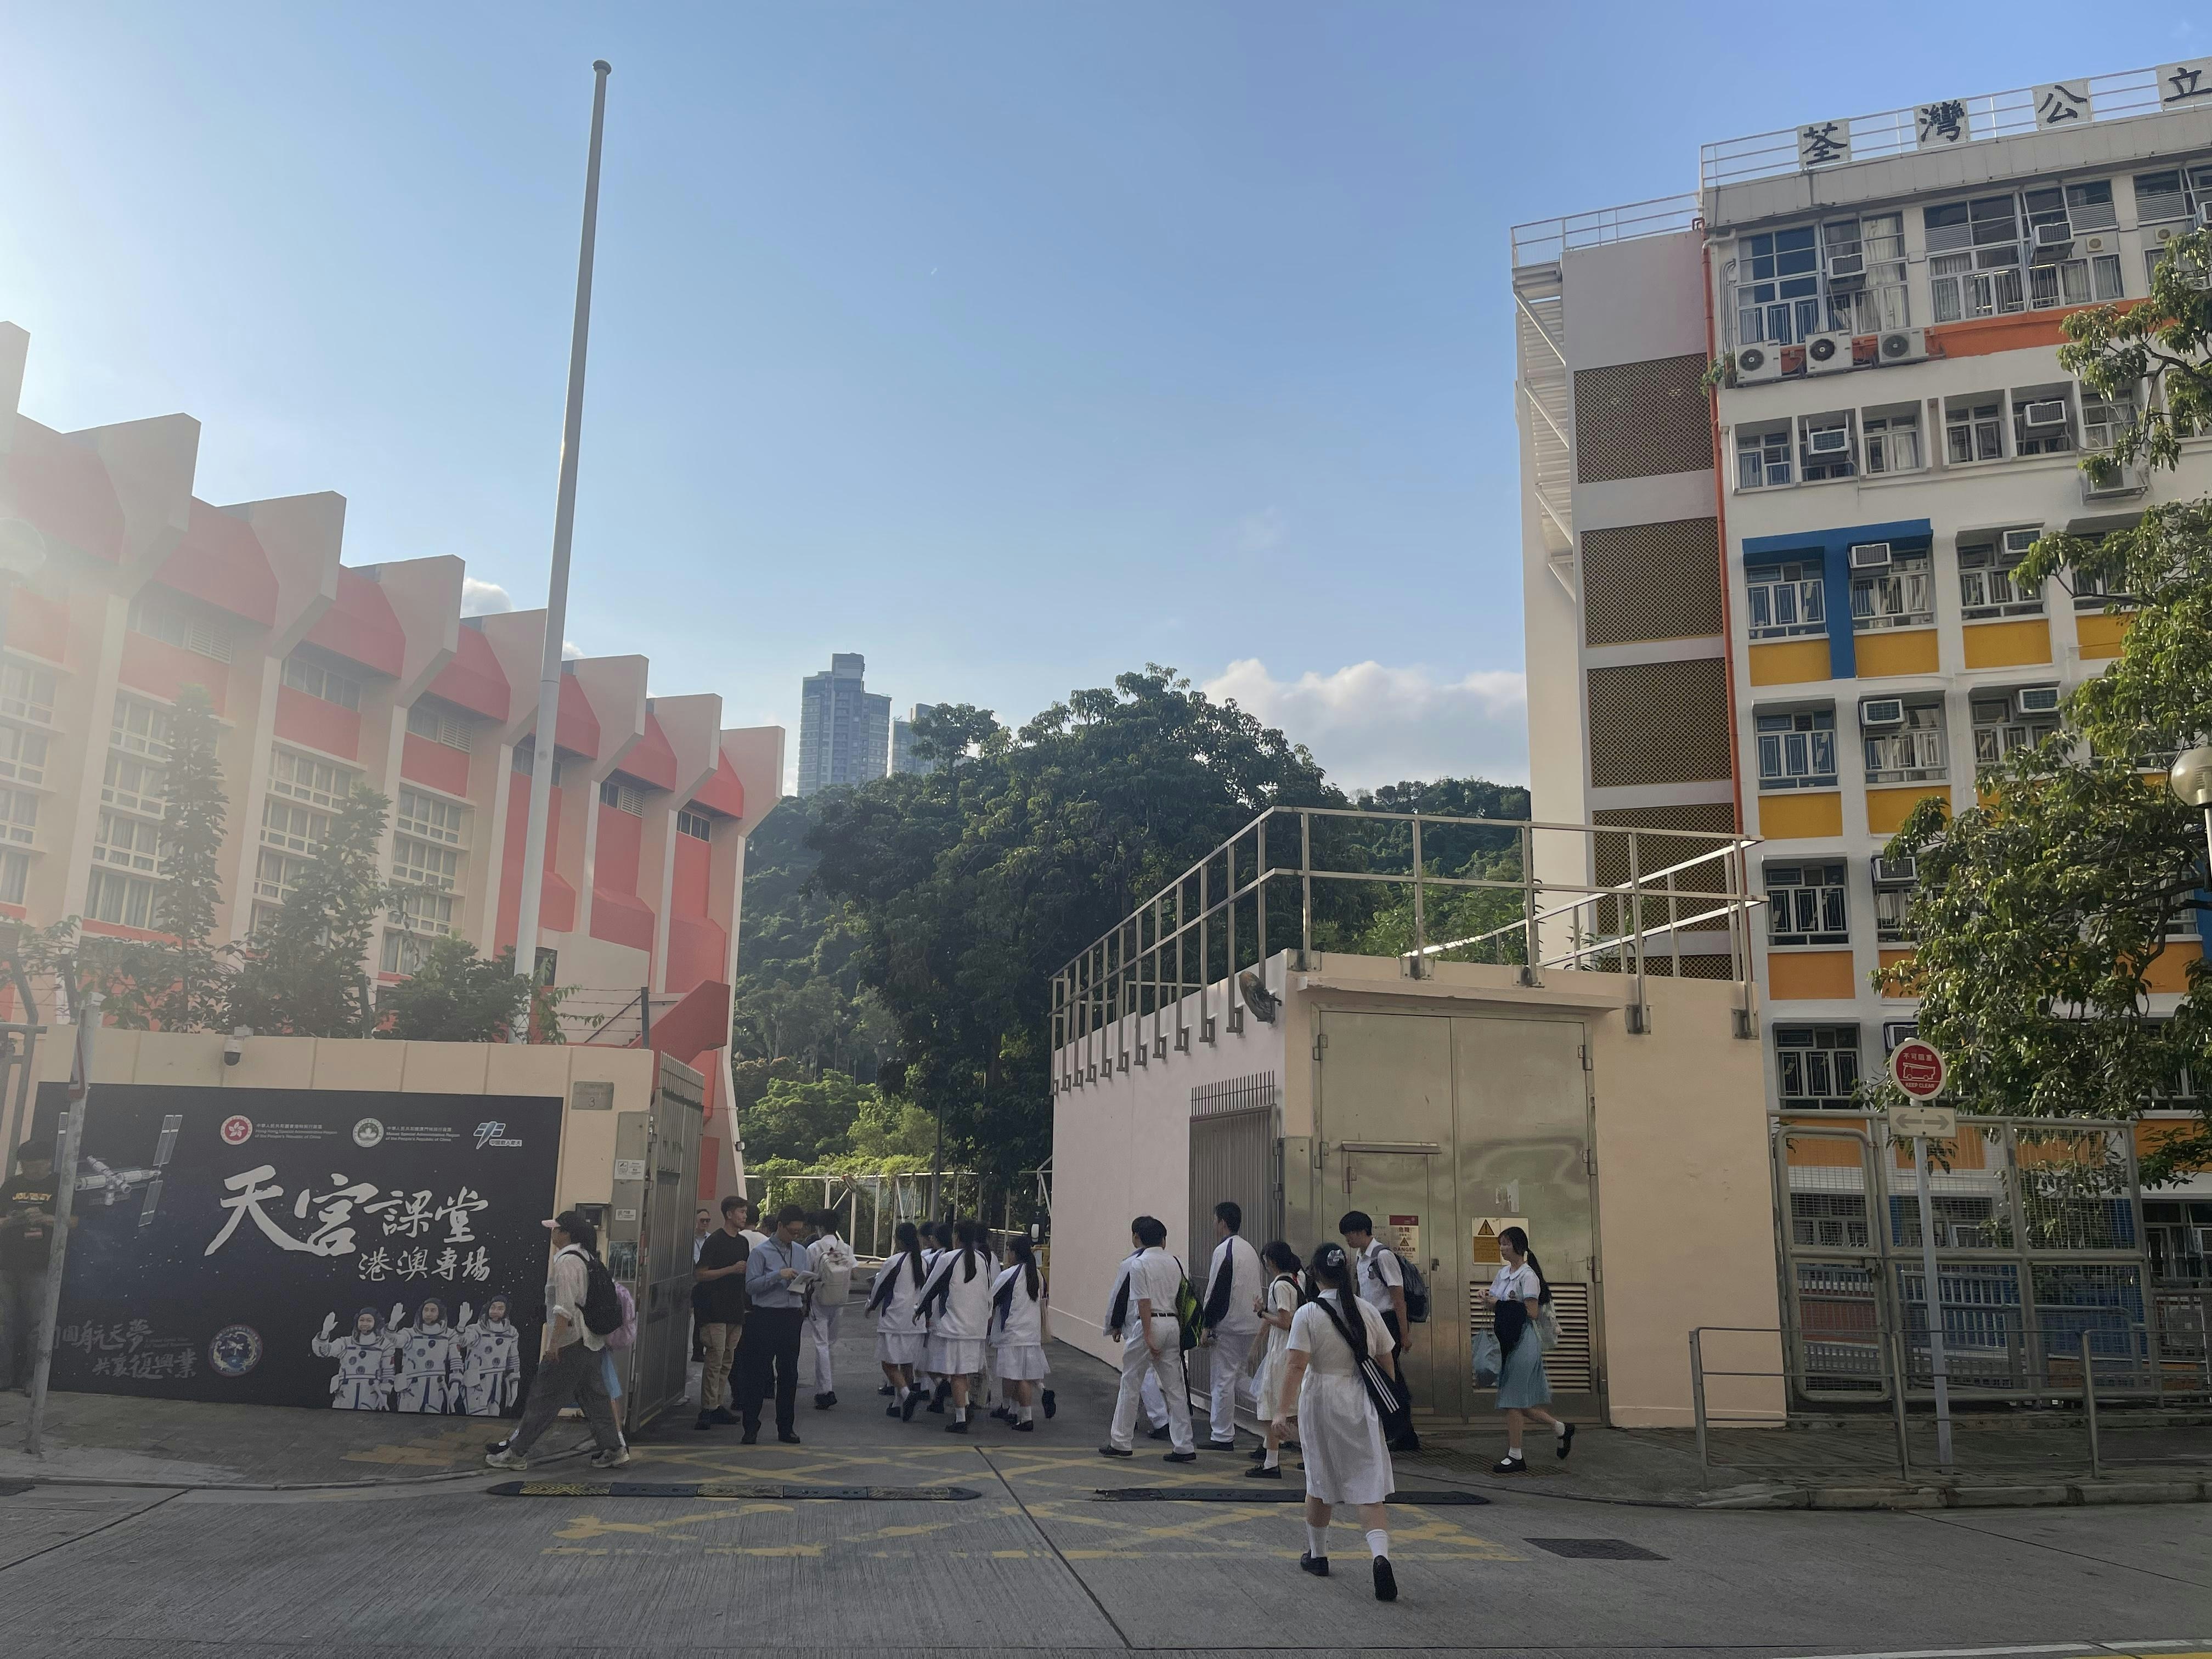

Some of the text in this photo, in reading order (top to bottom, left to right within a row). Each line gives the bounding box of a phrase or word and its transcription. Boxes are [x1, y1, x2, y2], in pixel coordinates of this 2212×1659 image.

[1803, 66, 2212, 165] 荃灣公立
[1903, 1052, 1932, 1061] 不可阻塞
[588, 1097, 595, 1107] 3
[358, 1246, 490, 1282] 港澳專場
